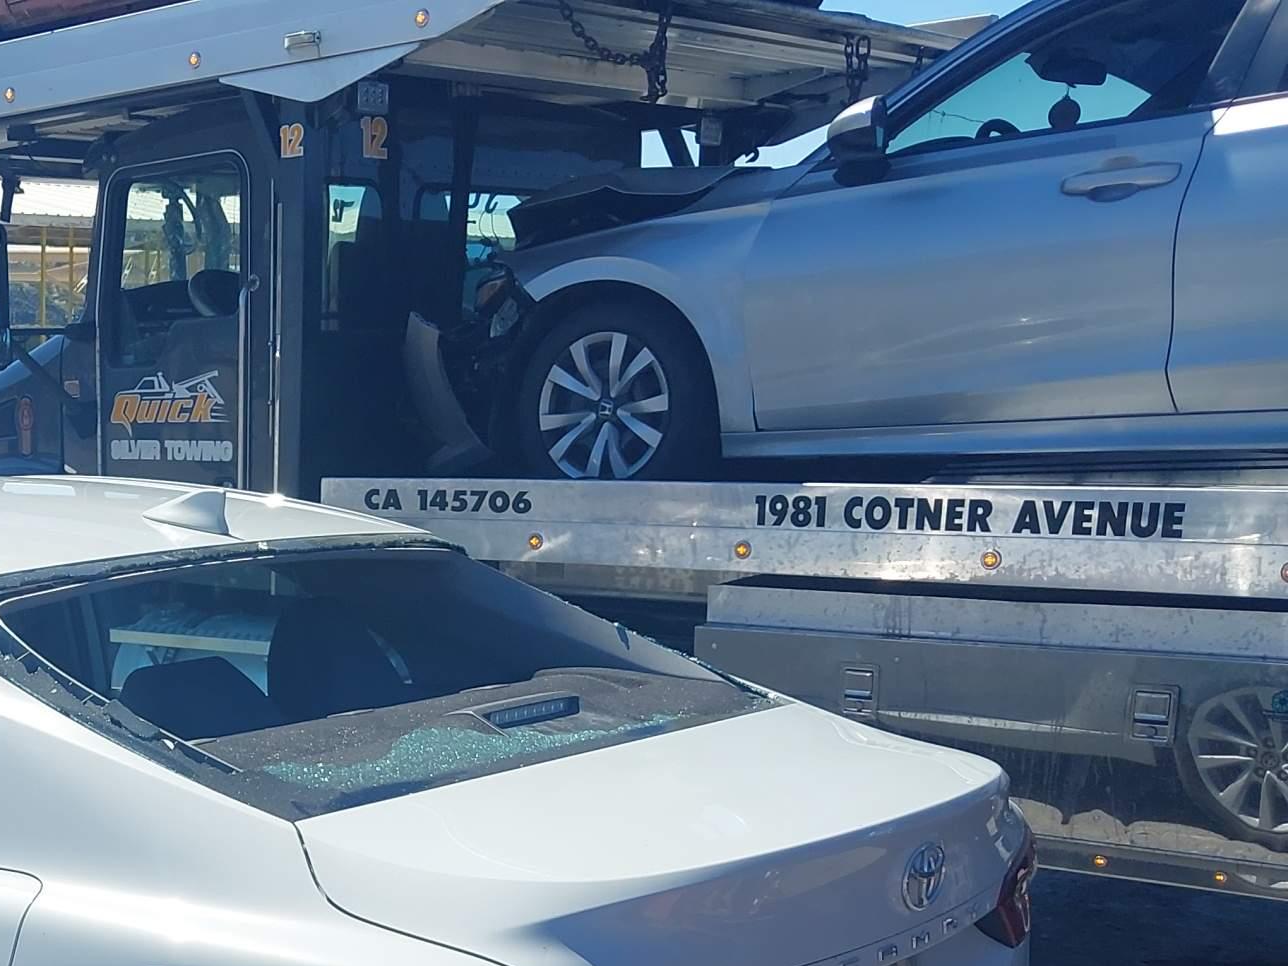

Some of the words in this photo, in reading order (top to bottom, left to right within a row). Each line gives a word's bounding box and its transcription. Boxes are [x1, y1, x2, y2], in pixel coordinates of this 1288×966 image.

[280, 123, 304, 158] 12
[360, 116, 388, 159] 12
[111, 440, 161, 460] SILVER
[165, 440, 233, 462] TOWING
[364, 489, 402, 510] CA
[417, 489, 532, 514] 145706
[755, 494, 826, 528] 1981
[843, 496, 993, 533] COTNER
[1012, 499, 1186, 538] AVENUE
